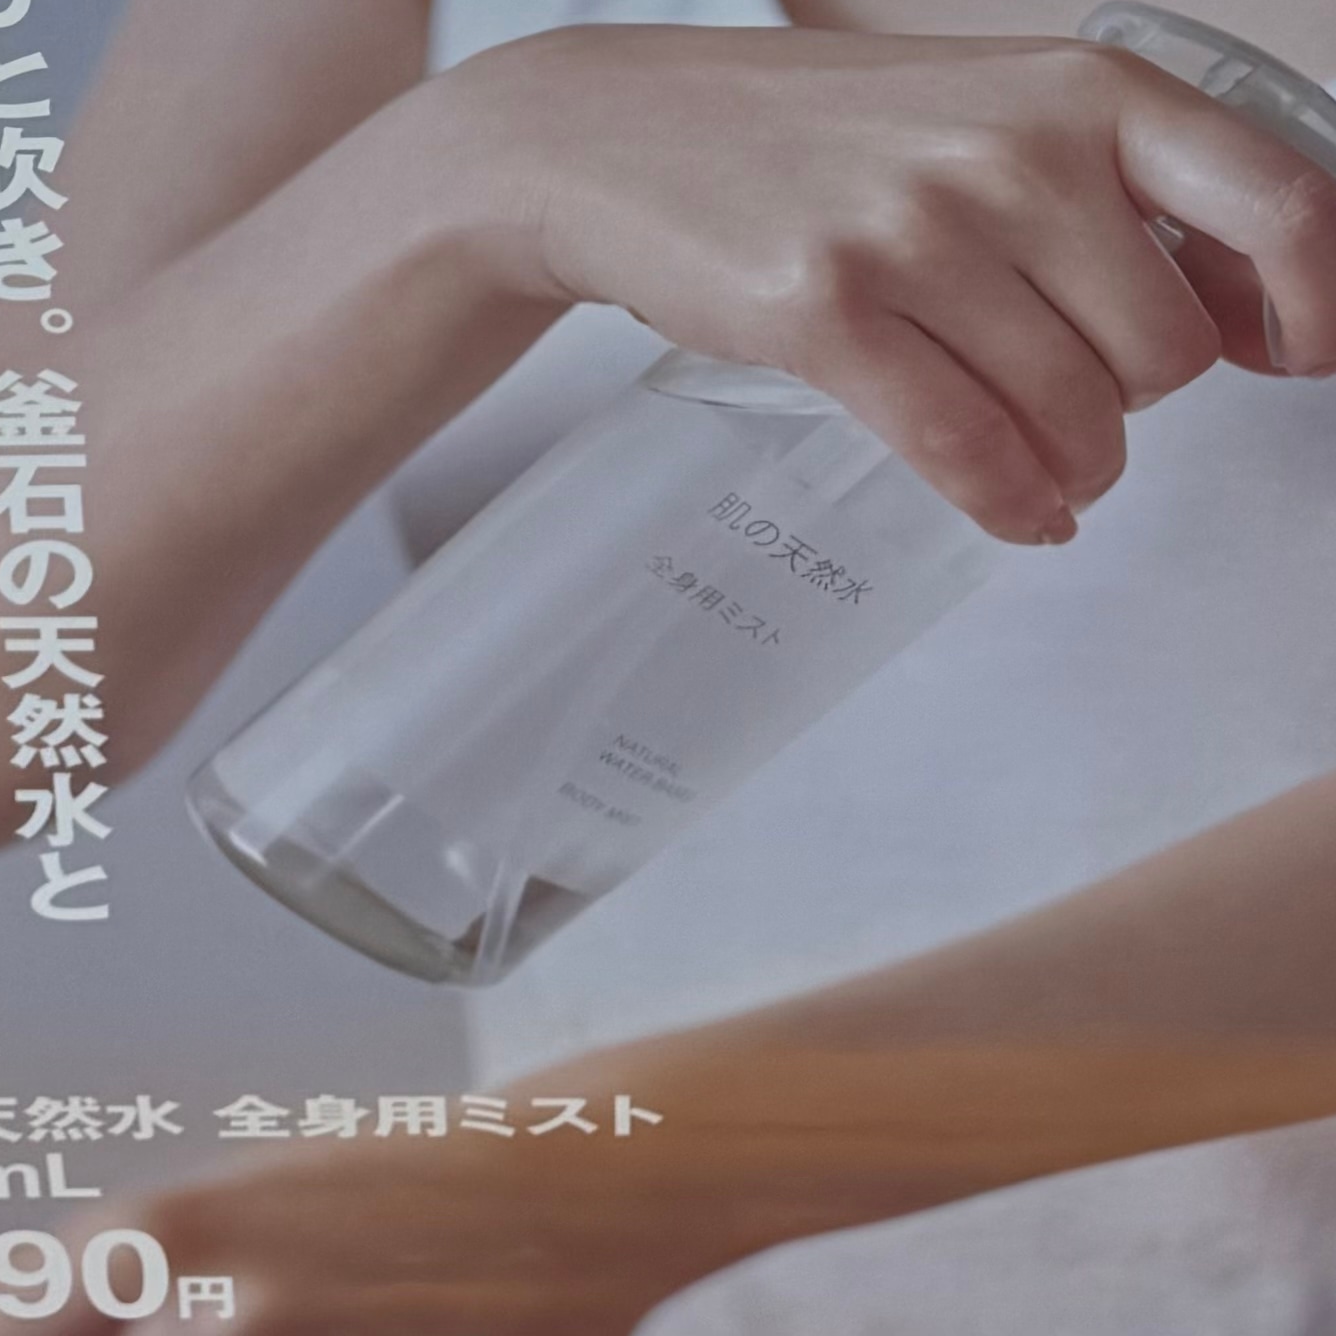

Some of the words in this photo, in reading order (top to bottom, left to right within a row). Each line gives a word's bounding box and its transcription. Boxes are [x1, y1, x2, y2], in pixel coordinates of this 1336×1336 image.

[707, 492, 874, 605] 肌の天然水
[645, 554, 781, 647] 全身用ミスト
[214, 1094, 664, 1138] 全身用ミスト
